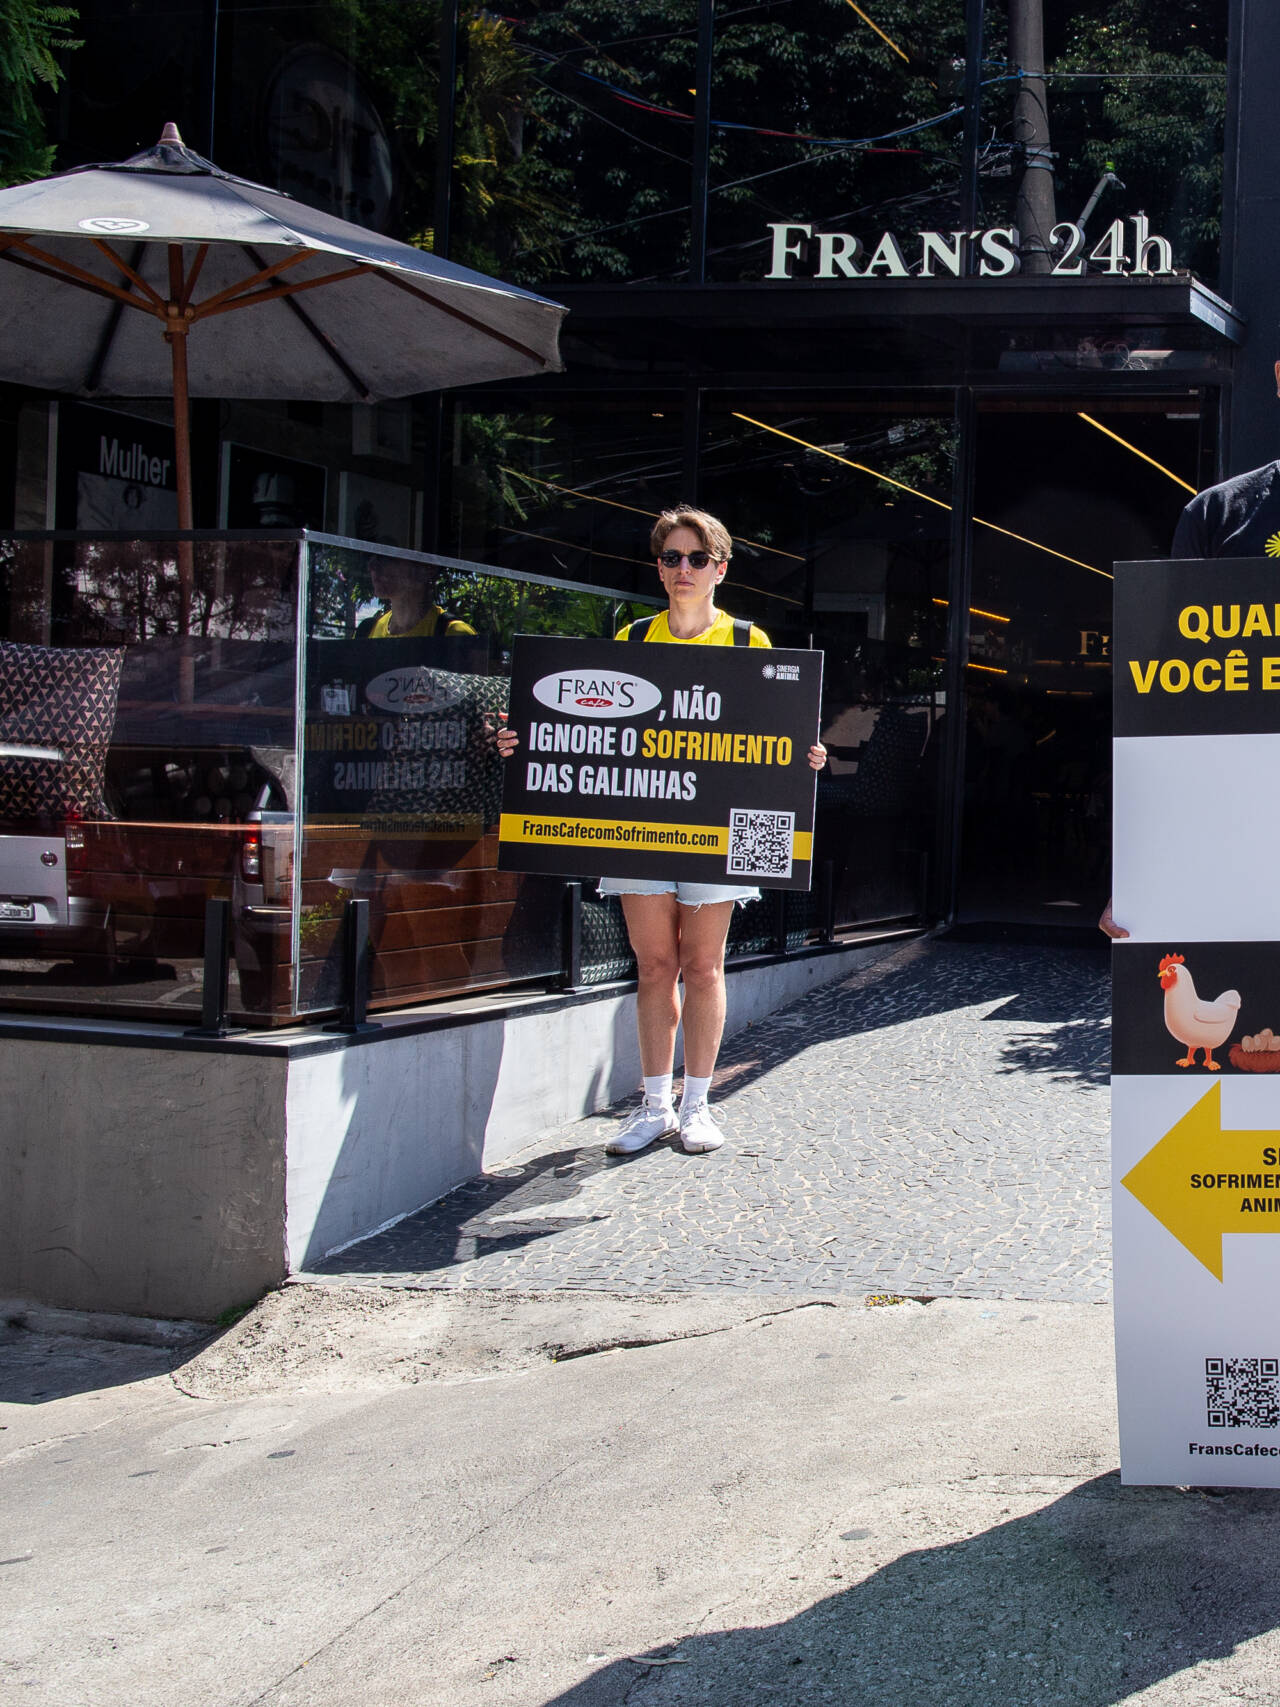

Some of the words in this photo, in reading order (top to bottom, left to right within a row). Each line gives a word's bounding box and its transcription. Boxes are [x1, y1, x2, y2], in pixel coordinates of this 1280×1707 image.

[1049, 211, 1178, 277] 24h
[100, 435, 170, 486] Mulher
[1128, 649, 1249, 693] VOCÊ
[557, 678, 635, 708] FRAN'S
[673, 685, 721, 721] NÃO
[529, 722, 615, 756] IGNORE
[621, 727, 637, 757] O
[642, 728, 792, 766] SOFRIMENTO
[526, 762, 573, 793] DAS
[578, 765, 697, 800] GALINHAS
[522, 820, 719, 847] FransCafecomSofrimento.com
